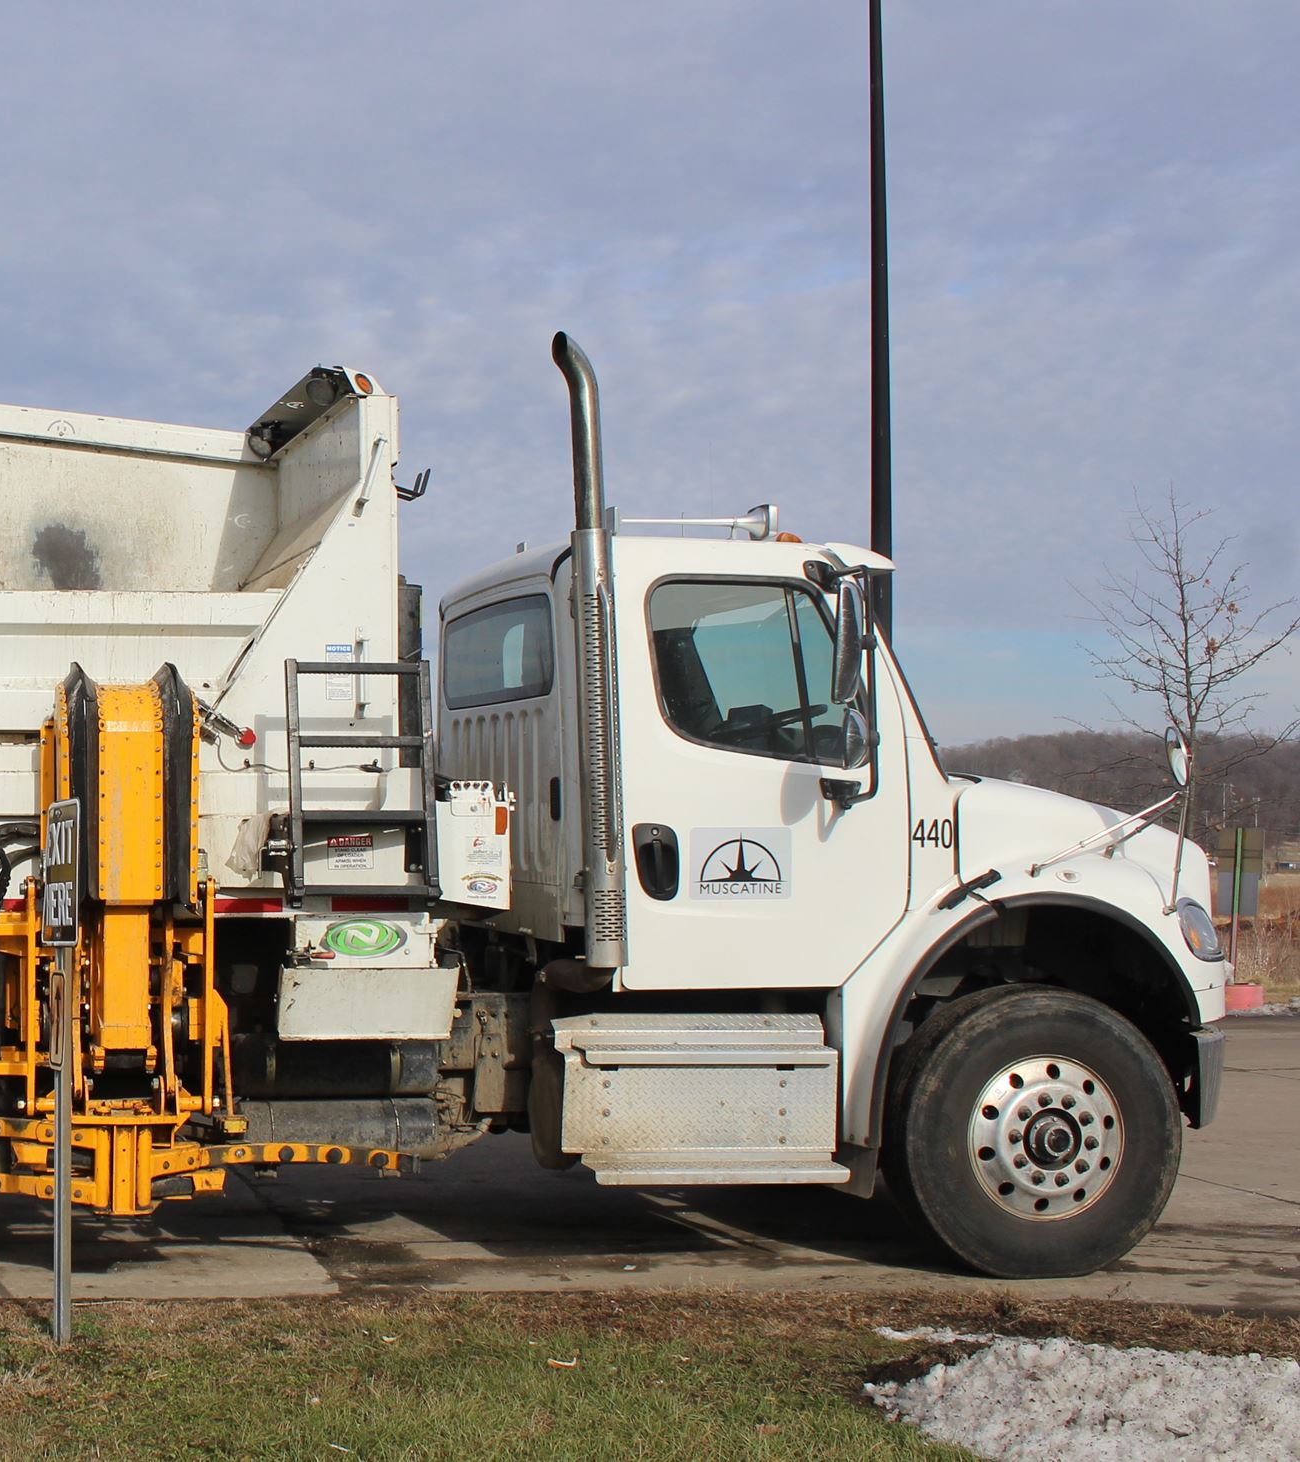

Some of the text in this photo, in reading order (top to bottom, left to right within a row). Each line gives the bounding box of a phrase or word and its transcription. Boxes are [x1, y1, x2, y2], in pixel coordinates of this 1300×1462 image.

[48, 820, 73, 865] EXIT
[339, 837, 371, 846] DANGER
[913, 818, 953, 849] 440
[699, 882, 782, 895] MUSCATINE
